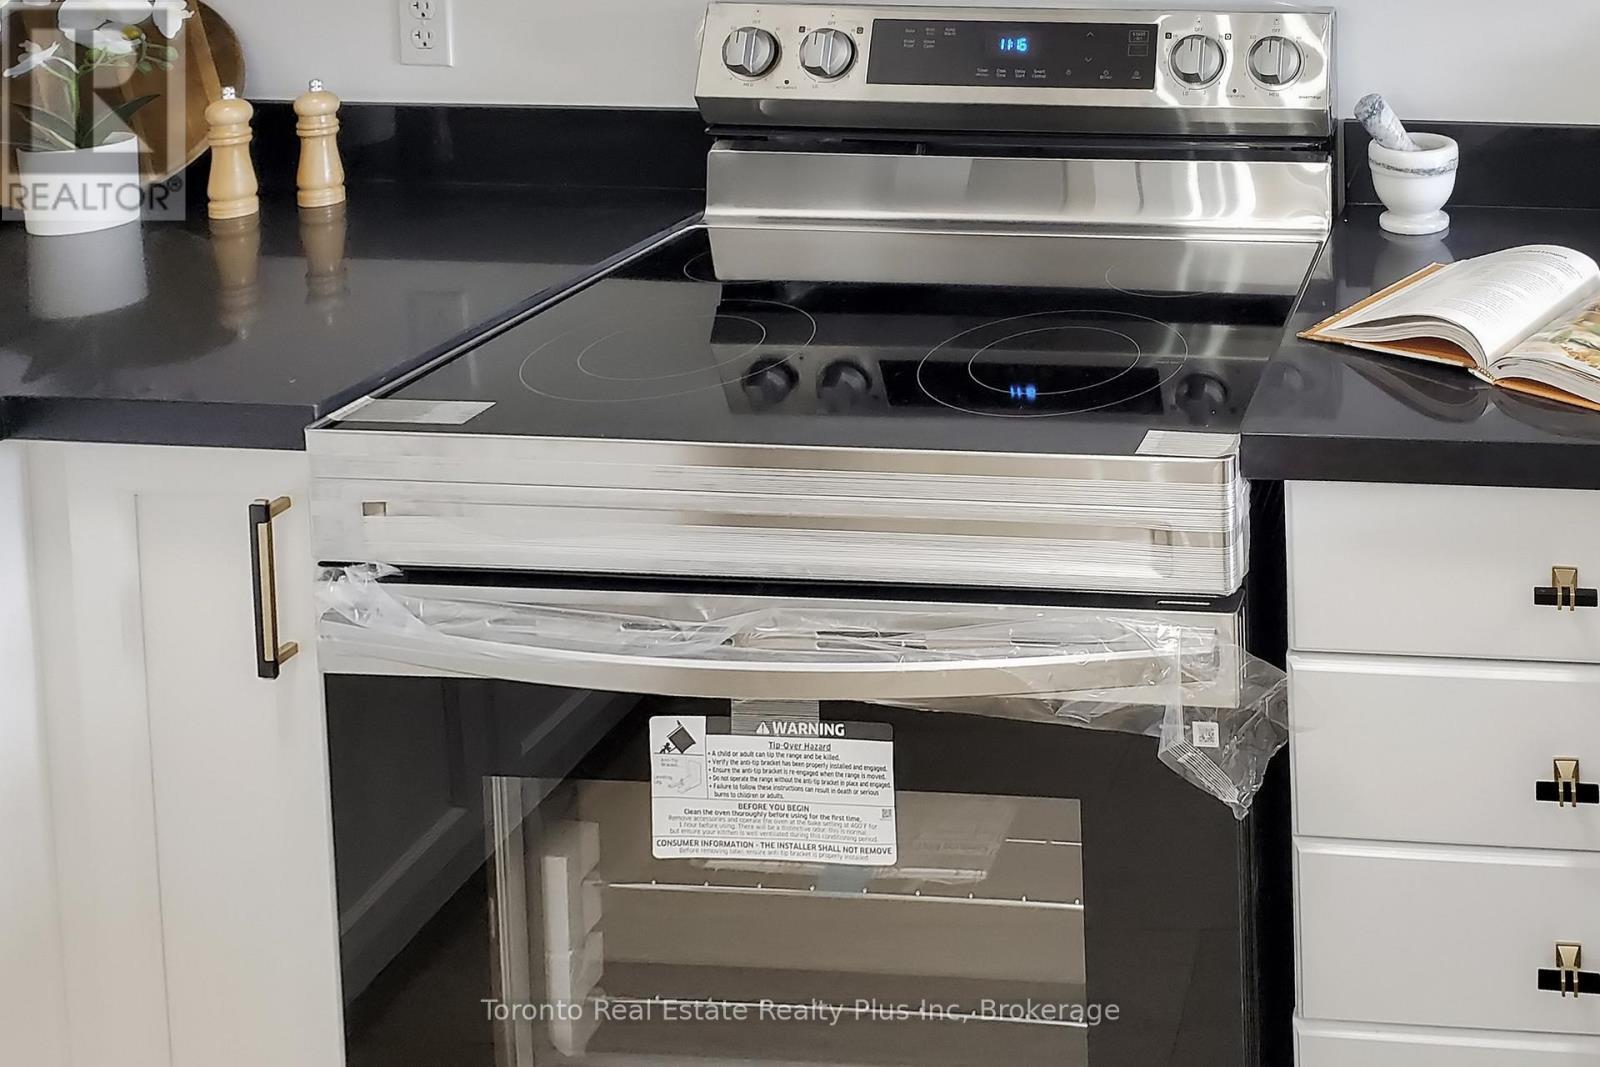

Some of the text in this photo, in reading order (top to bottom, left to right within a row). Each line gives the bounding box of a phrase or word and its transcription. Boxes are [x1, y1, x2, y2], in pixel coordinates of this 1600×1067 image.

[772, 721, 845, 736] WARNING
[804, 742, 832, 752] Hazard
[806, 762, 828, 770] properly
[738, 802, 767, 810] BEFORE
[787, 804, 809, 812] BEGIN
[732, 810, 767, 819] thoroughly
[790, 812, 808, 821] using
[656, 839, 699, 847] CONSUMER
[701, 840, 754, 849] INFORMATION
[777, 842, 817, 851] INSTALLER
[818, 844, 841, 852] SHALL
[859, 846, 892, 855] REMOVE
